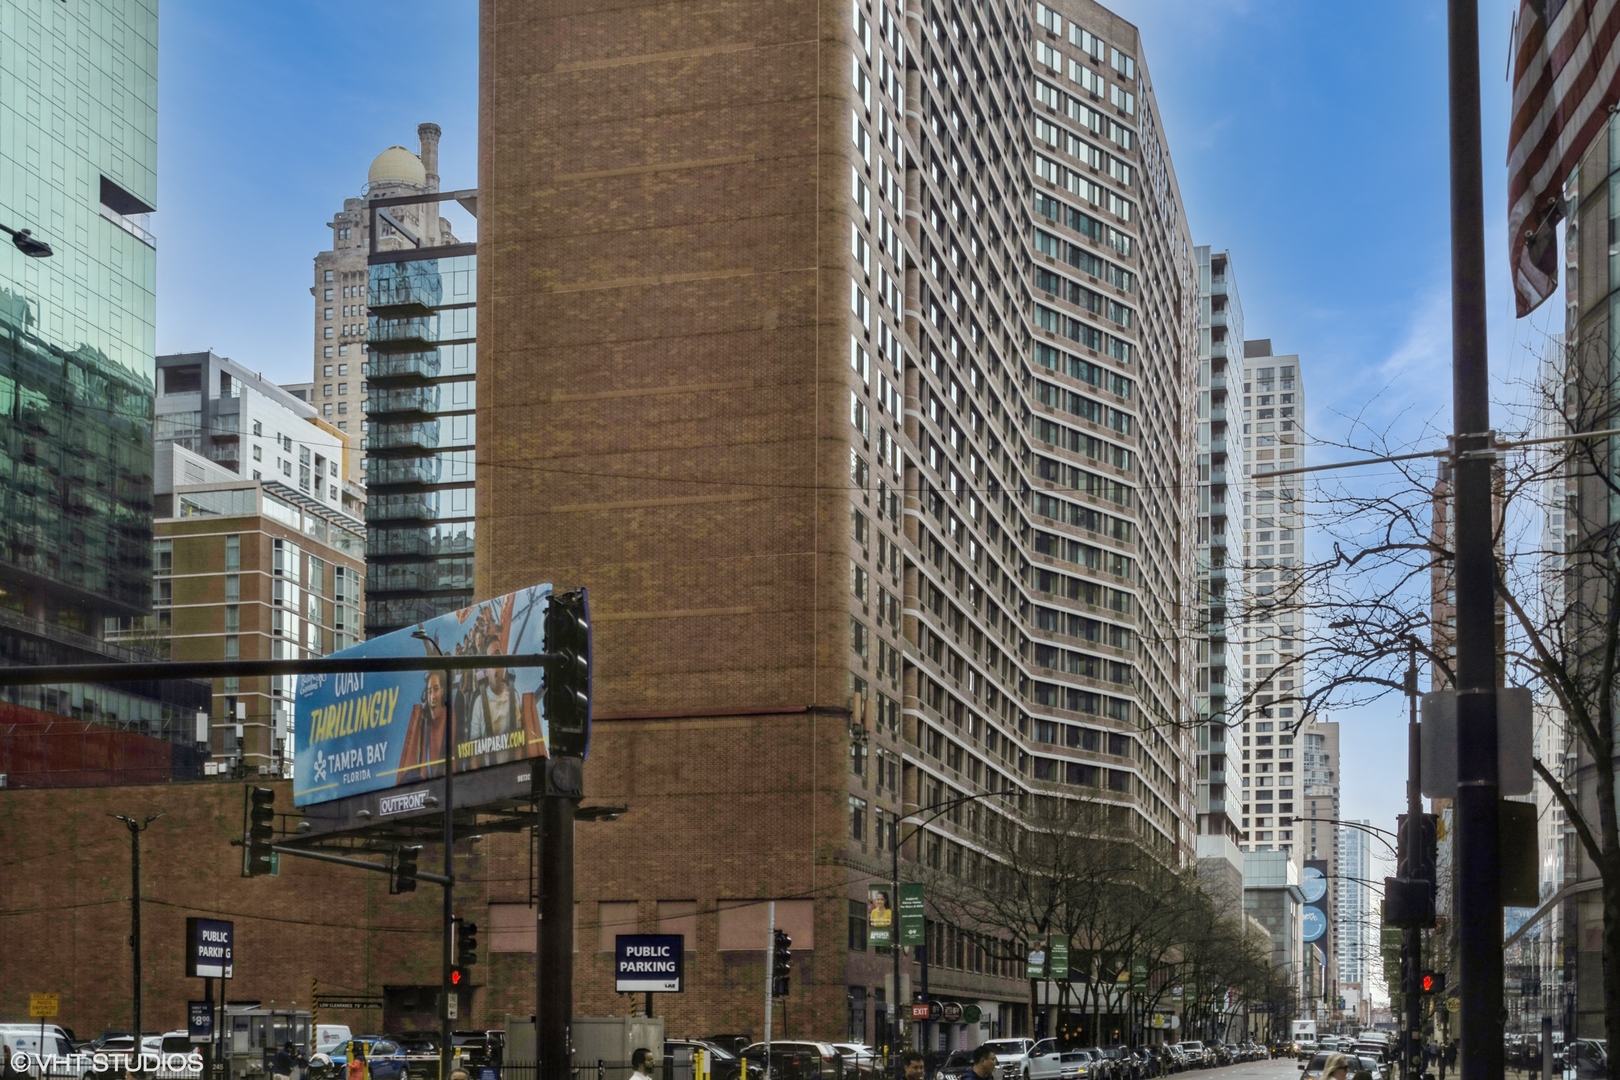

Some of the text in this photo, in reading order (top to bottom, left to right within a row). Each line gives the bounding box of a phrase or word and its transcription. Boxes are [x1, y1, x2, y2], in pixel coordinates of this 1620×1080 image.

[309, 686, 399, 745] THRILLINGLY
[457, 730, 526, 759] VISITTAMPABAY.COM
[328, 741, 388, 774] TAMPA BAY
[343, 769, 371, 784] FLORIDA
[381, 793, 426, 813] OUTFRONT
[203, 930, 228, 942] PUBLIC
[626, 946, 670, 957] PUBLIC
[620, 961, 676, 972] PARKING
[913, 1007, 928, 1016] EXIT
